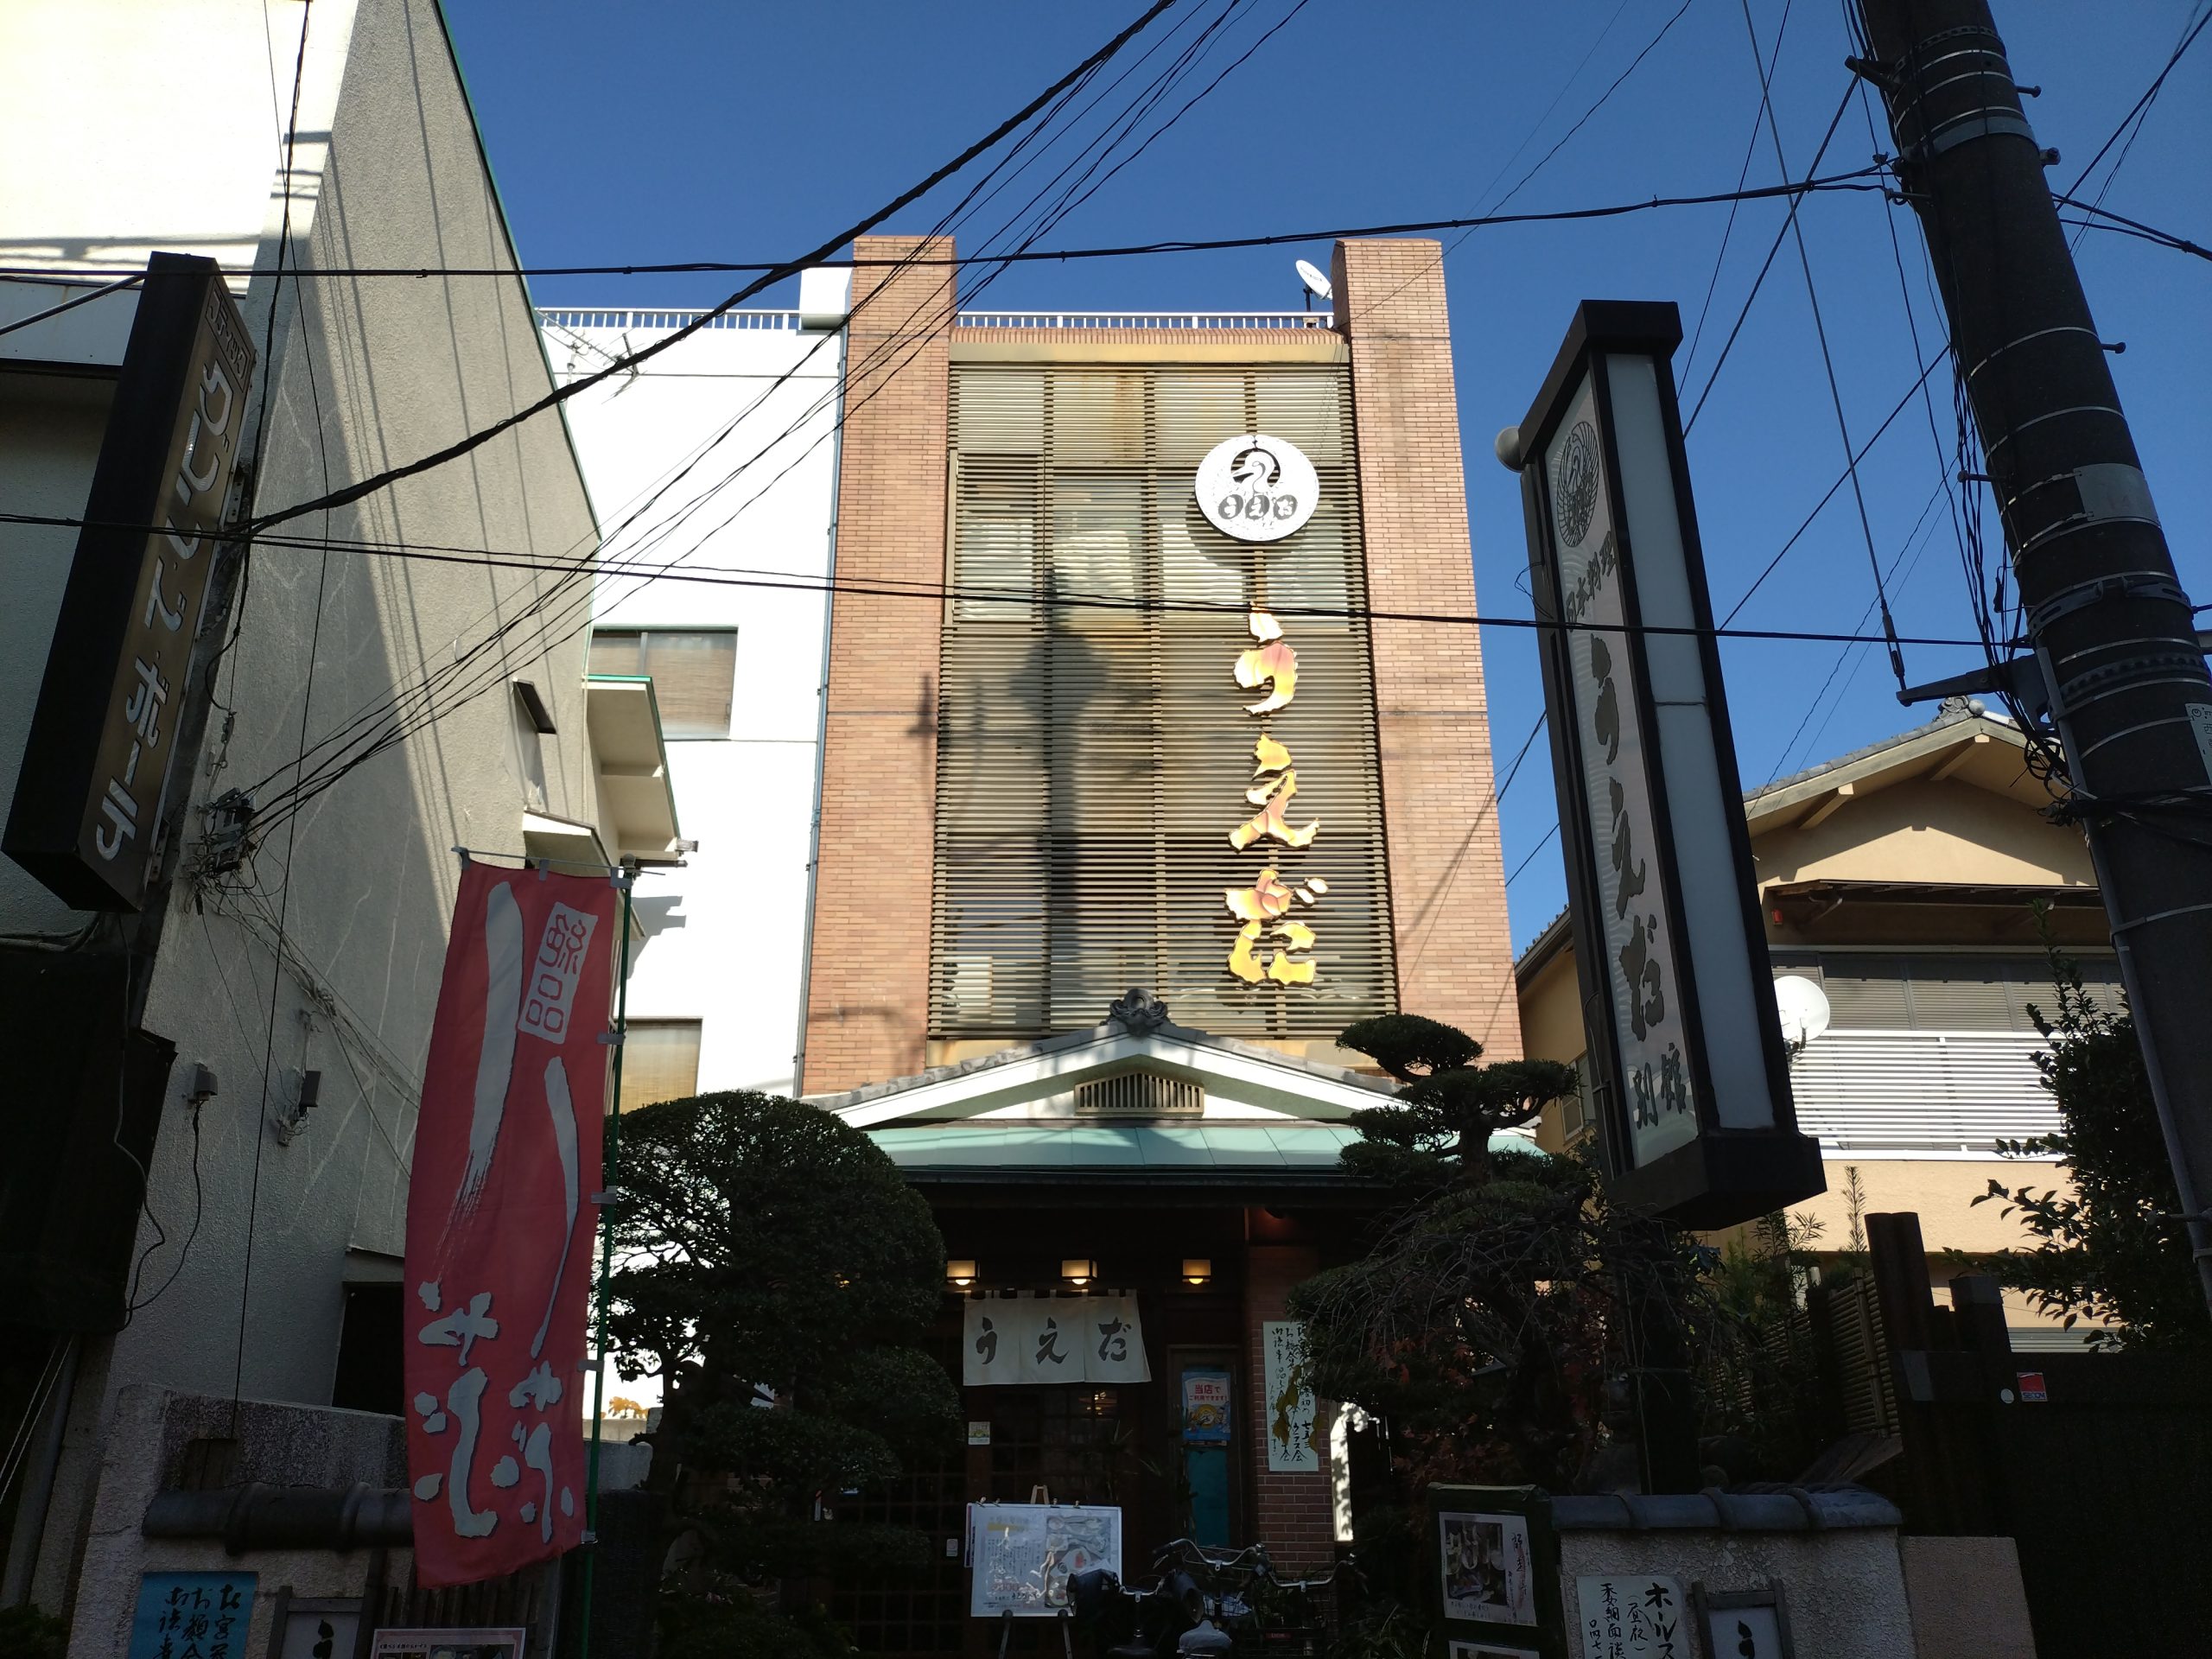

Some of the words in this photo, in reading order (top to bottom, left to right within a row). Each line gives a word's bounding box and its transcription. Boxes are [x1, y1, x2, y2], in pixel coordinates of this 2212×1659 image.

[1566, 531, 1616, 632] 日本料理
[1224, 604, 1328, 986] うえだ
[1591, 632, 1664, 1042] うえだ
[1633, 1041, 1687, 1129] 別館
[976, 1316, 1130, 1365] うえだ
[1195, 1384, 1221, 1395] 当店で
[1643, 1581, 1677, 1659] ホールス
